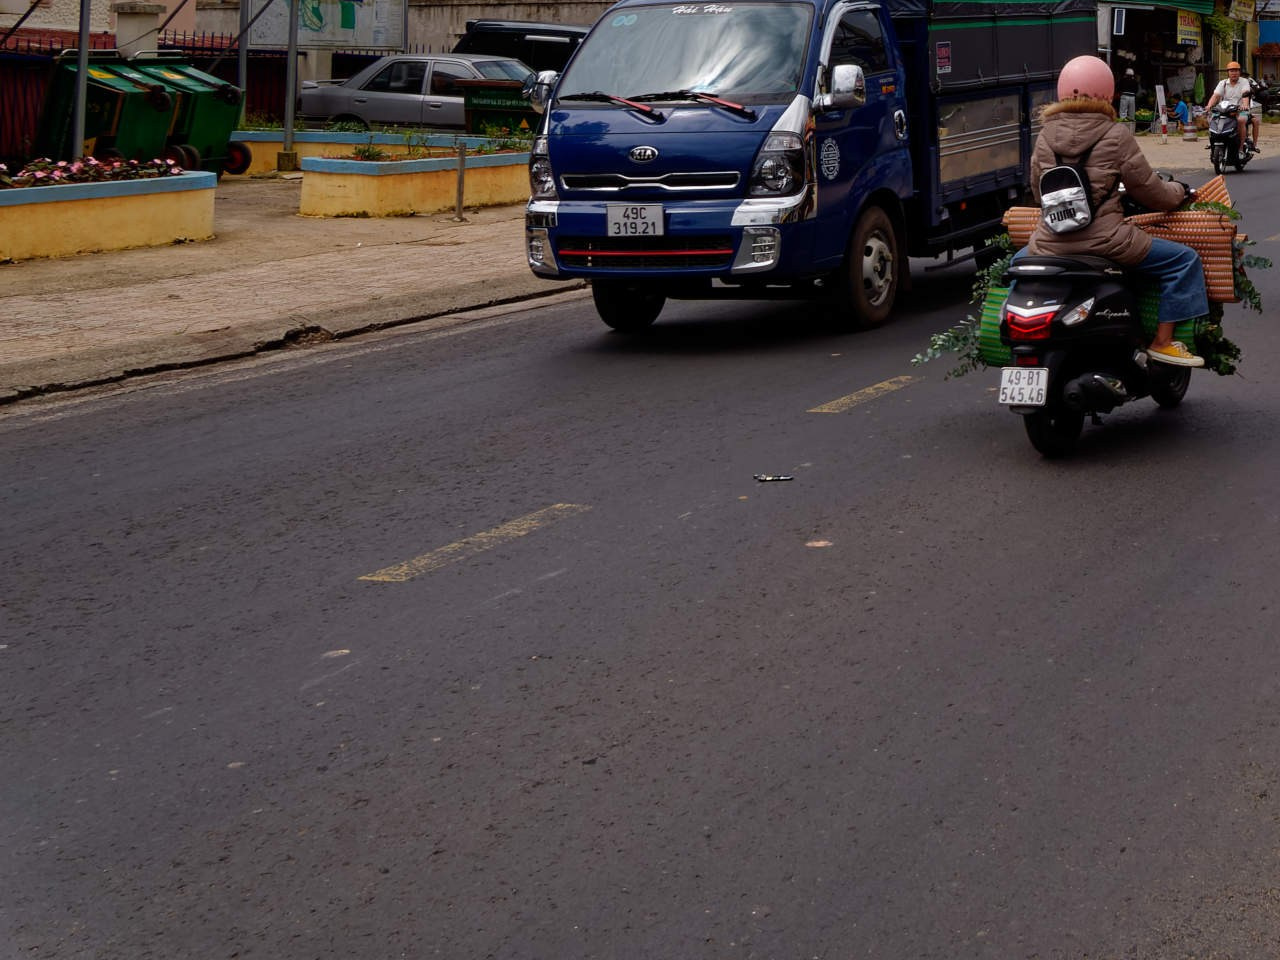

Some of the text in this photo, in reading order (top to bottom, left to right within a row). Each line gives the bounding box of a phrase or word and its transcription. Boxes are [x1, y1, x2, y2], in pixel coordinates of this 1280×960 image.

[633, 149, 653, 159] KIA
[623, 207, 647, 221] 49C
[1050, 206, 1077, 224] PUMA
[613, 222, 656, 235] 319.21
[1007, 371, 1041, 387] 49-B1
[1001, 388, 1044, 404] 545.46
